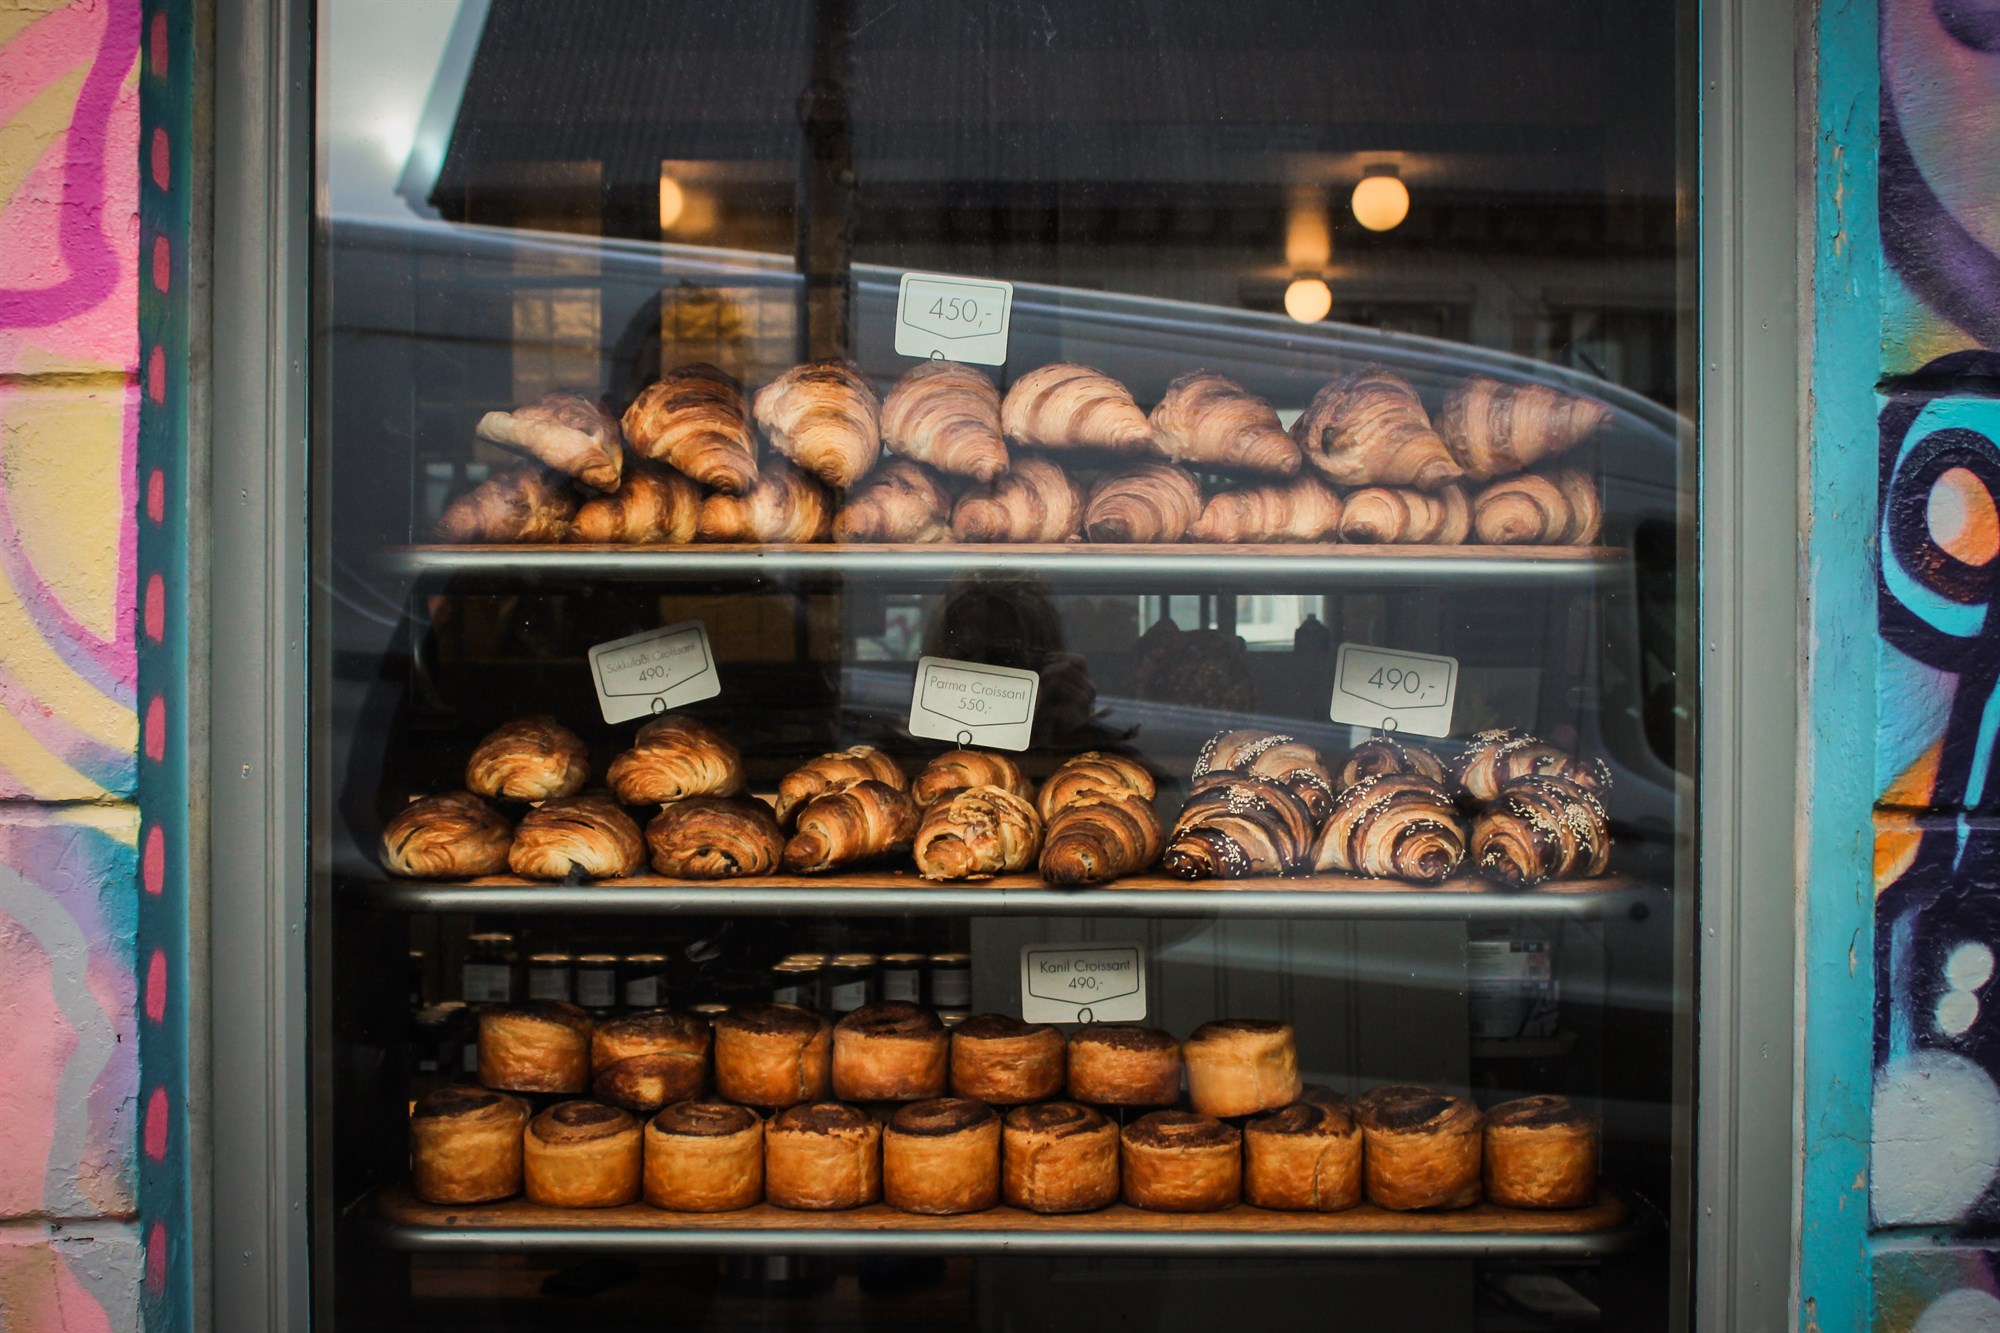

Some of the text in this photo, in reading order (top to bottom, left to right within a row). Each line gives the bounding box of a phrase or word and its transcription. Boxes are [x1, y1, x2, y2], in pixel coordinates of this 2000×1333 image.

[928, 296, 992, 328] 450,-
[652, 642, 696, 661] Croissant
[638, 665, 672, 682] 490,-
[929, 675, 1026, 701] Parma Croissant
[1367, 666, 1435, 700] 490,-
[958, 697, 992, 714] 550,-
[1039, 959, 1130, 973] Kanil Croissant
[1068, 976, 1103, 990] 490,-
